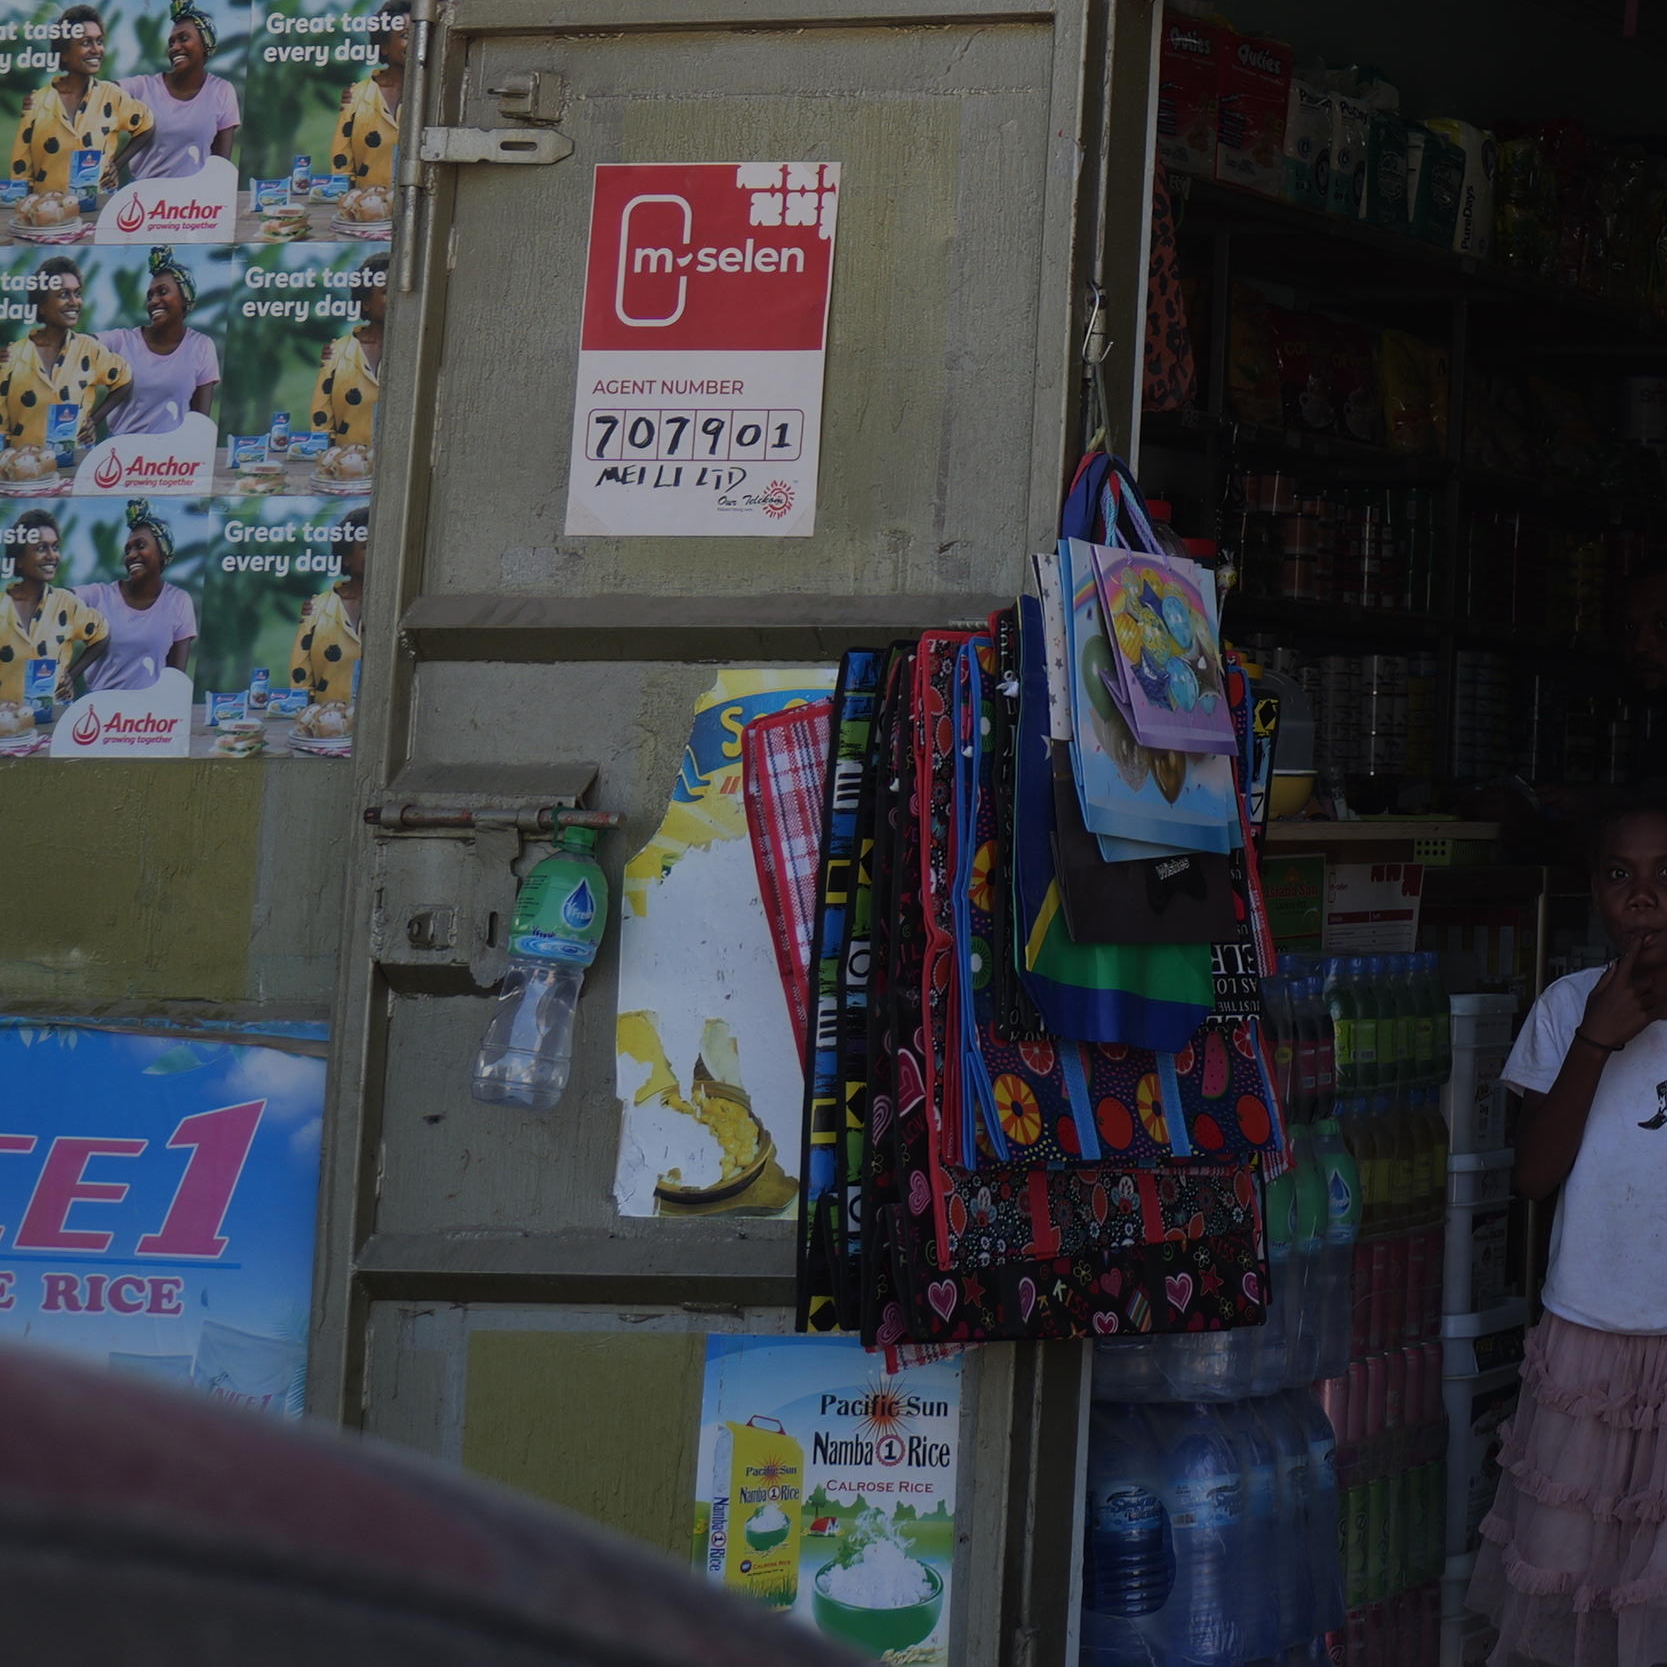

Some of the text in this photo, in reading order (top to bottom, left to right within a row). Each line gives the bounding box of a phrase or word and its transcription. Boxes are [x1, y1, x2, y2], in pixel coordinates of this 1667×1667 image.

[23, 21, 85, 40] taste
[266, 12, 404, 35] Great taste
[16, 47, 62, 74] day
[264, 39, 380, 67] every day
[149, 200, 223, 220] Anchor
[147, 220, 218, 232] growing together
[245, 267, 316, 289] Great
[593, 380, 744, 395] AGENT NUMBER
[595, 415, 791, 458] 707901
[125, 456, 200, 476] Anchor
[224, 520, 296, 543] Great
[103, 712, 178, 734] Anchor
[41, 1273, 184, 1316] RICE
[820, 1394, 948, 1417] Pacific Sun
[813, 1432, 950, 1468] Namba Rice
[826, 1479, 934, 1493] CALROSE RICE
[709, 1549, 725, 1571] Rice
